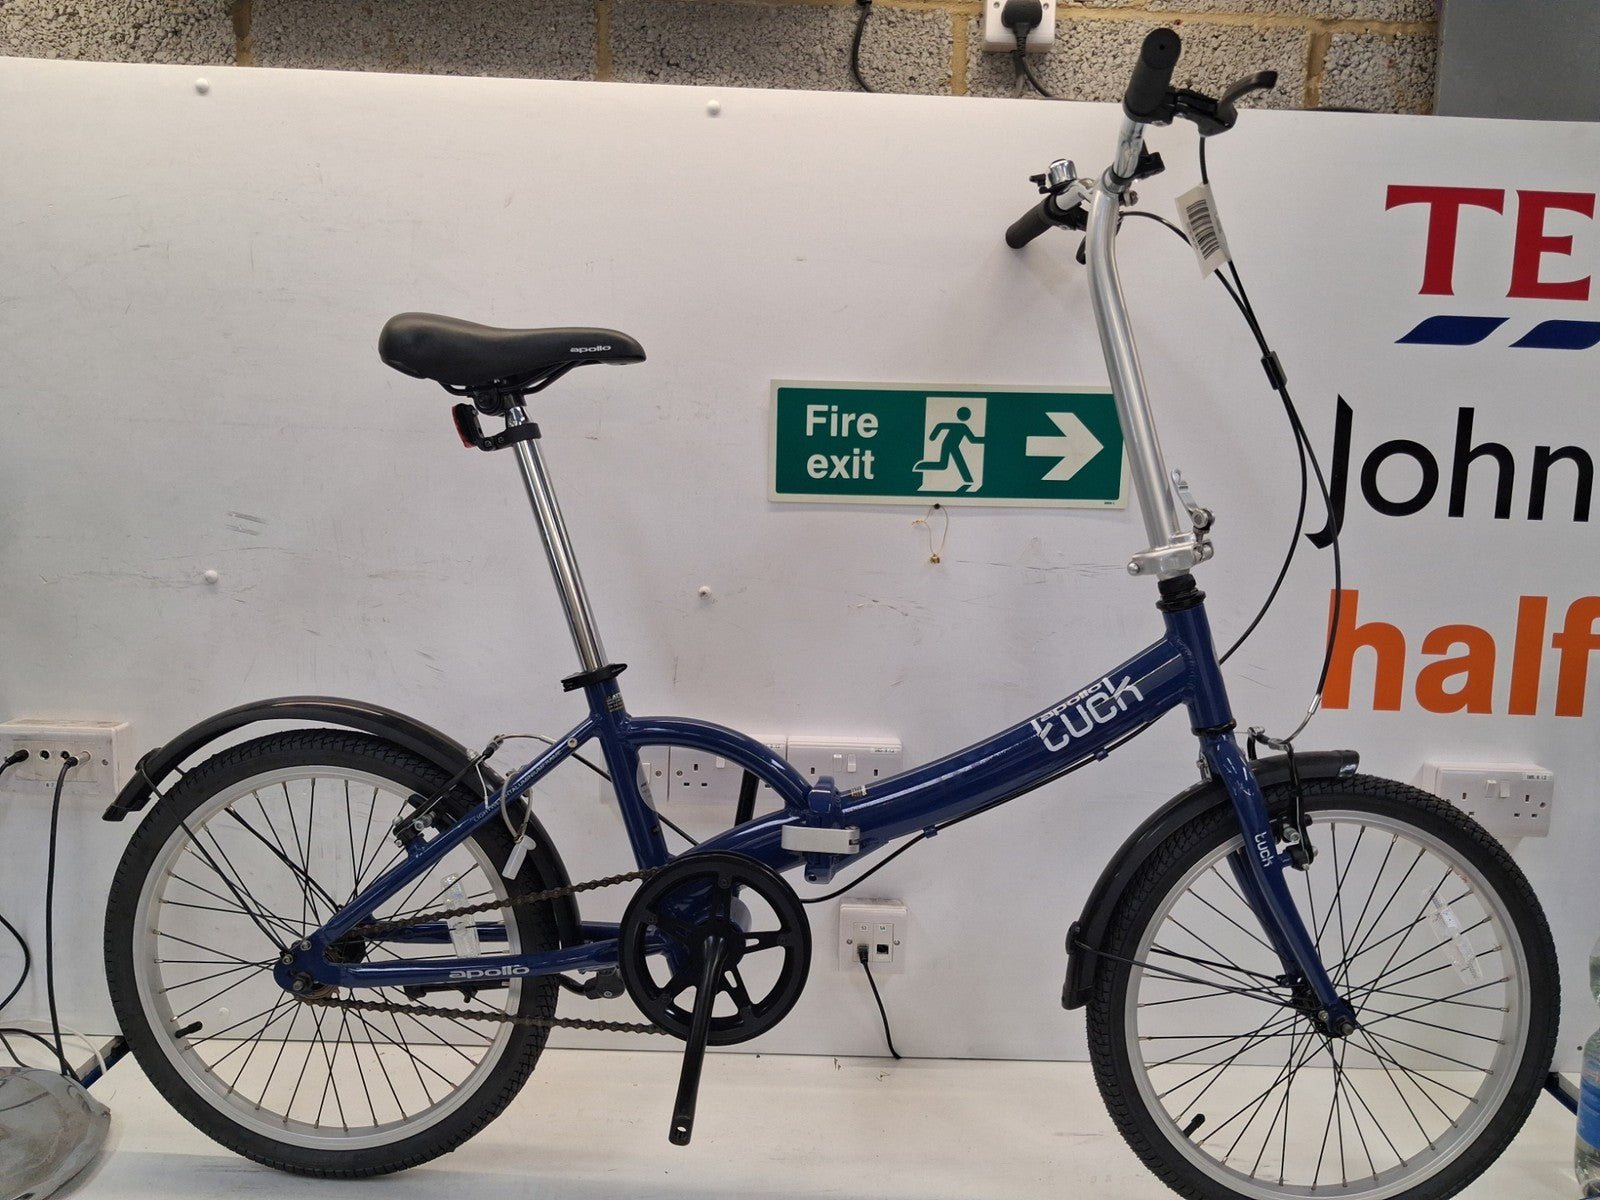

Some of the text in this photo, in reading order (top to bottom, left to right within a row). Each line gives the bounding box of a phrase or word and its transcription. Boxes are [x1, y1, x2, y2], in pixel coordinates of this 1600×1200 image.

[1385, 184, 1596, 301] TE
[569, 345, 612, 354] apollo
[805, 404, 879, 437] Fire
[806, 448, 875, 480] exit
[1304, 393, 1595, 550] John
[1320, 588, 1600, 718] half
[1030, 675, 1144, 752] tuck
[1254, 831, 1275, 868] tuck
[448, 965, 530, 979] apollo
